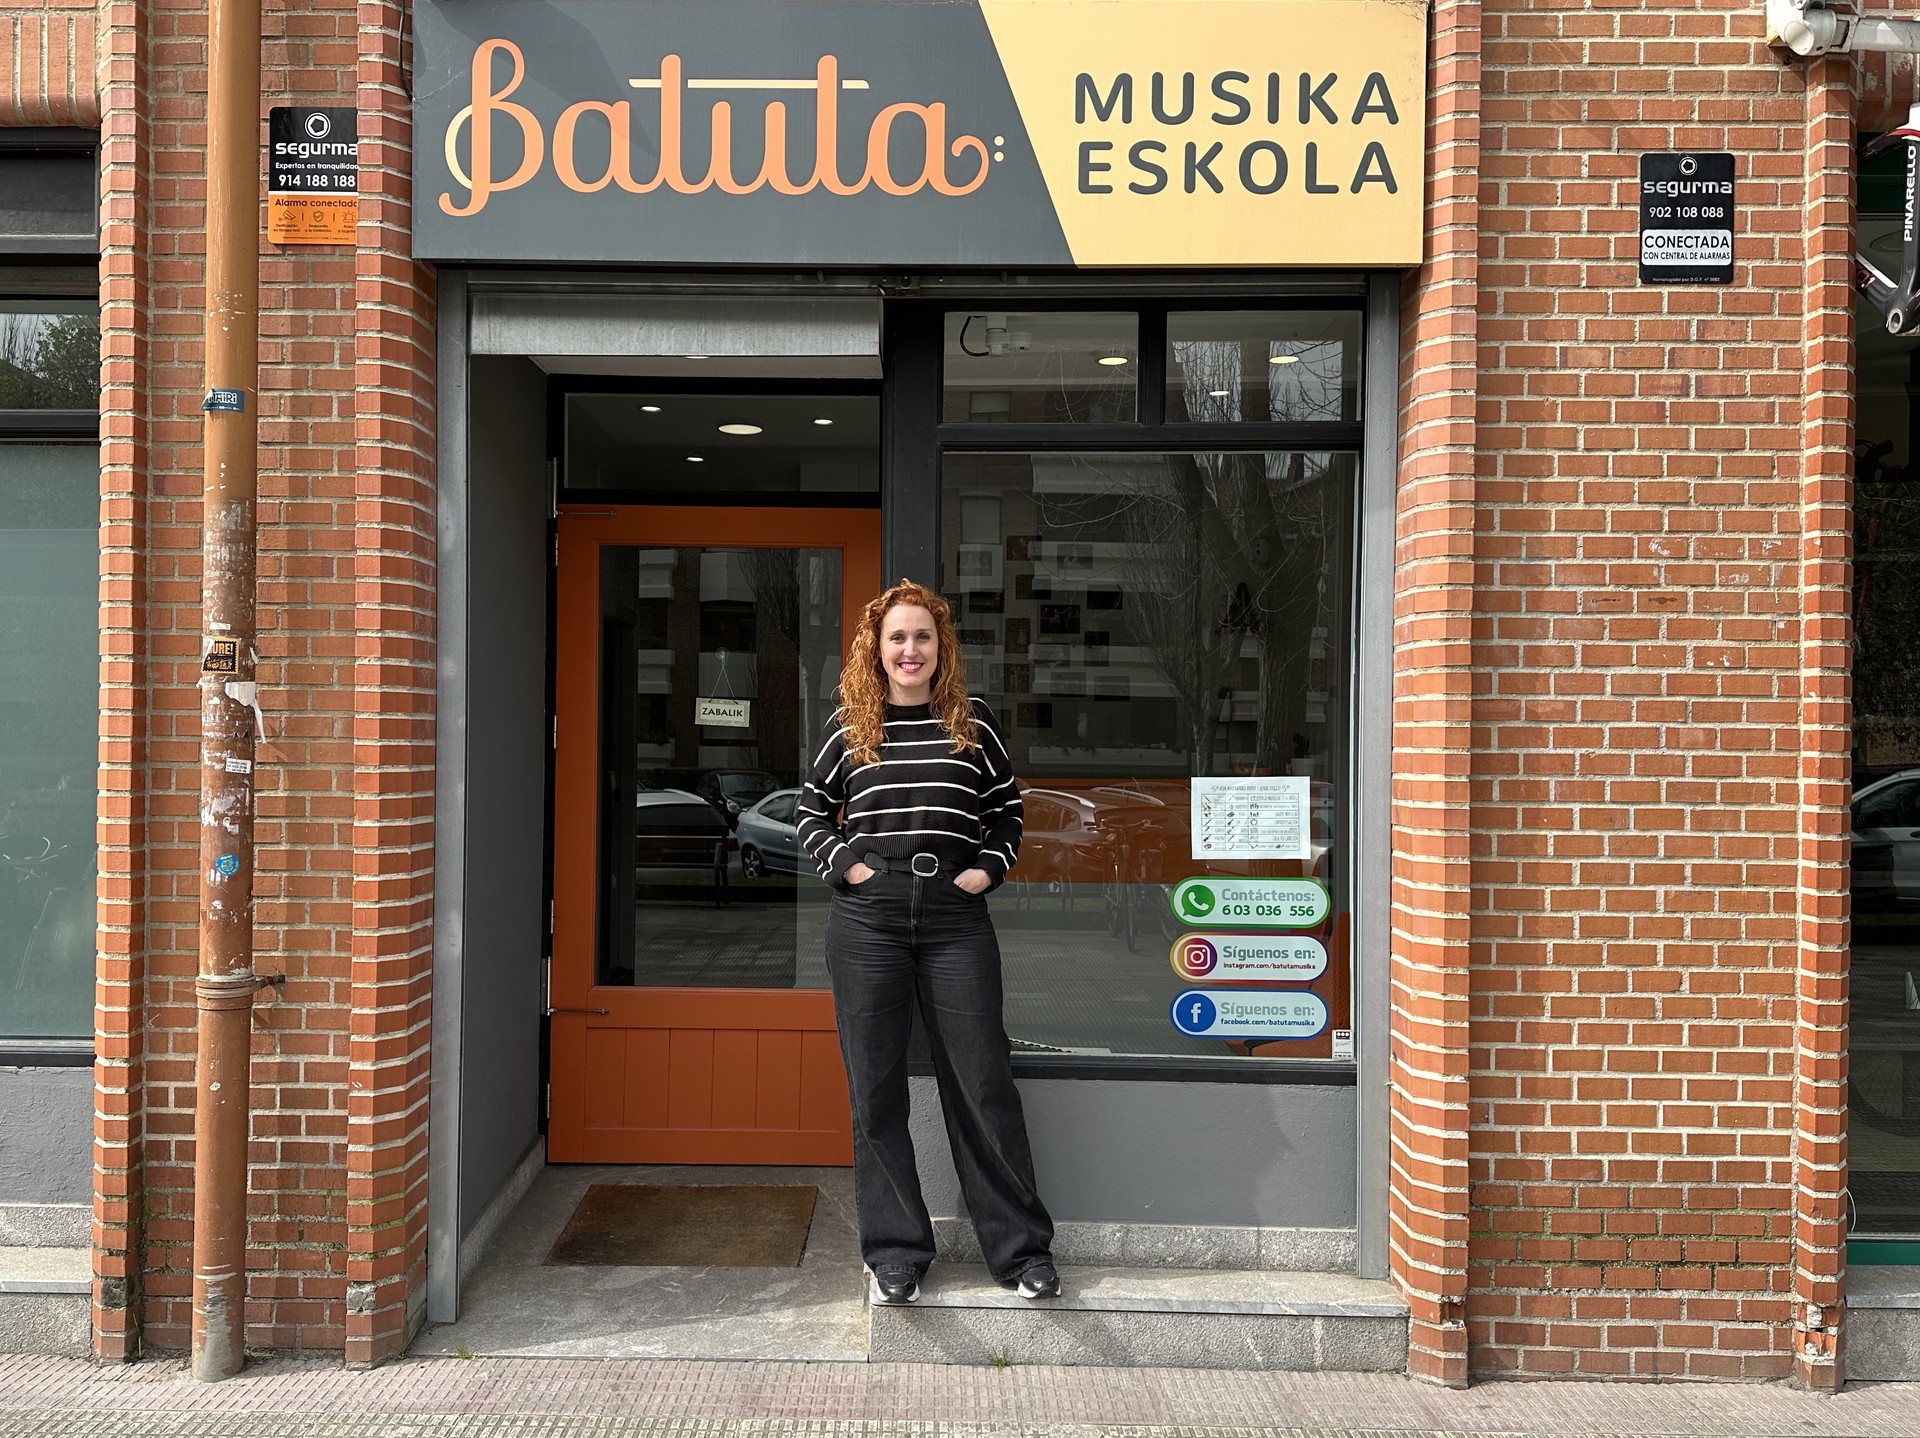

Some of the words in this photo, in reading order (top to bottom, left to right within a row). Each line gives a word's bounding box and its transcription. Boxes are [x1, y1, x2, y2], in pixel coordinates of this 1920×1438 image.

[1074, 71, 1400, 126] MUSIKA
[275, 142, 358, 158] segurma
[275, 162, 305, 171] Expertos
[1076, 140, 1400, 196] ESKOLA
[278, 174, 301, 187] 914
[305, 174, 328, 187] 188
[333, 174, 356, 187] 188
[1643, 181, 1733, 197] segurma
[1904, 145, 1917, 242] PINARELLO
[275, 198, 307, 208] Alarma
[1649, 206, 1671, 218] 902
[1676, 206, 1698, 218] 108
[1701, 206, 1724, 218] 088
[1644, 235, 1730, 249] CONECTADA
[1643, 251, 1659, 260] CON
[1660, 251, 1688, 260] CENTRAL
[1689, 251, 1698, 260] DE
[1699, 251, 1730, 260] ALARMAS
[208, 642, 234, 655] URE!
[702, 707, 743, 717] ZABALIK
[1221, 888, 1315, 902] Contáctenos:
[1255, 904, 1282, 916] 036
[1289, 905, 1315, 917] 556
[1223, 945, 1289, 961] Síguenos
[1294, 949, 1316, 959] en:
[1223, 962, 1316, 970] instagram.com/batutamusika
[1220, 1001, 1287, 1018] Síguenos
[1293, 1006, 1315, 1016] en:
[1220, 1018, 1315, 1026] facebook.com/batutamusika
